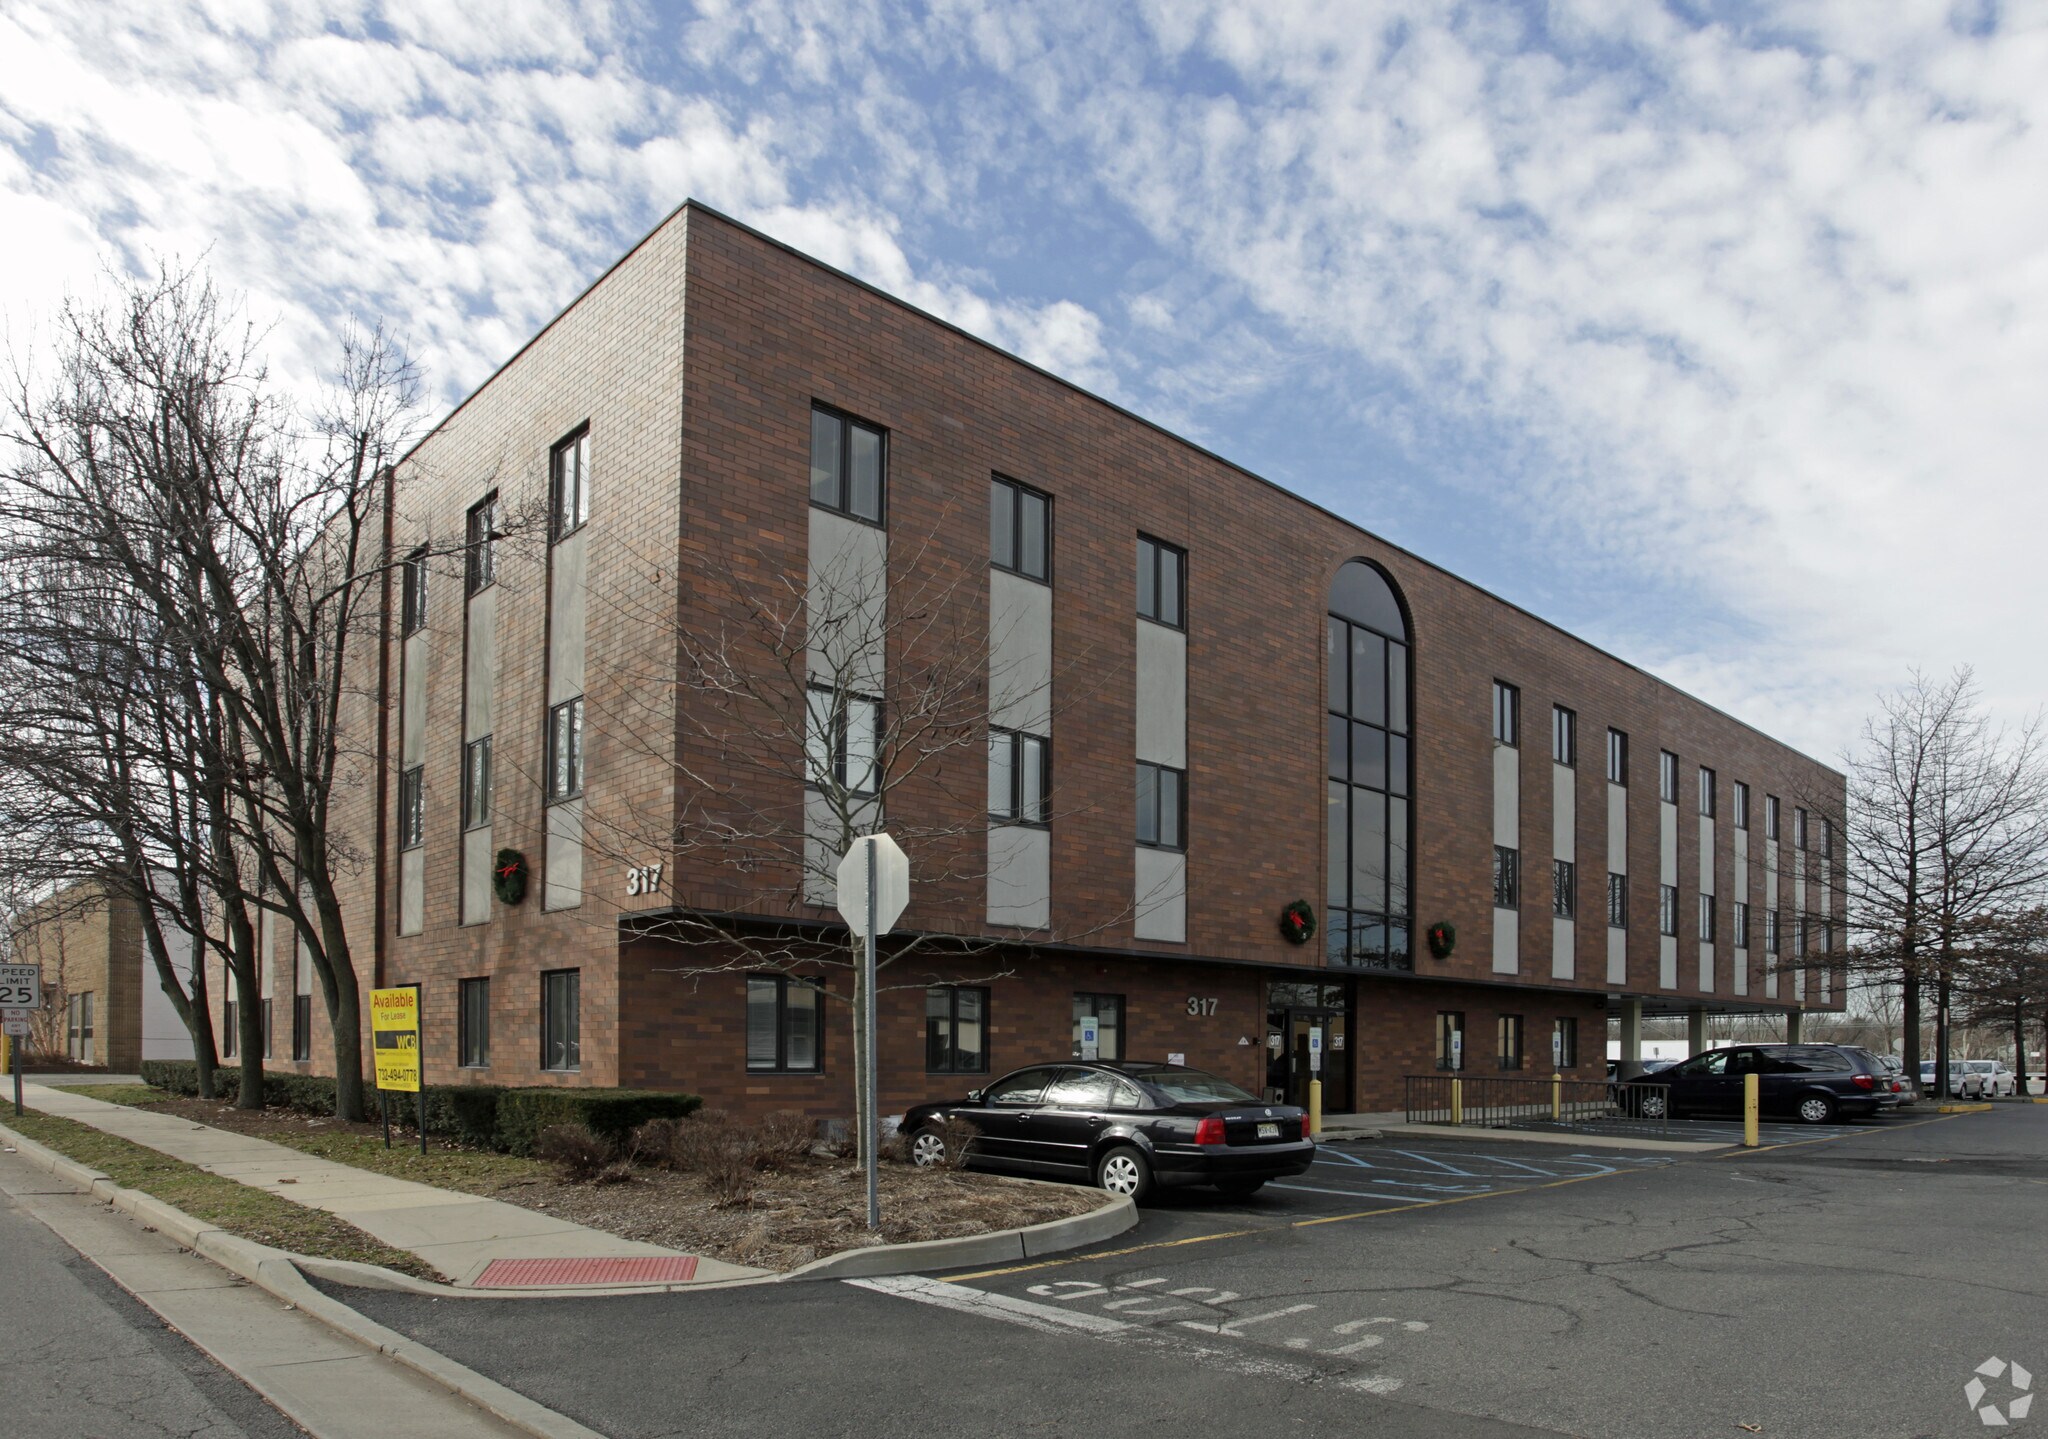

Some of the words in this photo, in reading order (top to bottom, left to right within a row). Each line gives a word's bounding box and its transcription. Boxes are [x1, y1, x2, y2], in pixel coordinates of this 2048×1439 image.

[626, 863, 663, 895] 317
[0, 987, 32, 1003] 25
[373, 993, 413, 1008] Available
[1187, 996, 1218, 1016] 317
[380, 1012, 389, 1020] For
[390, 1012, 406, 1020] Lease
[396, 1035, 416, 1049] WCB
[1270, 1035, 1280, 1045] 317
[1333, 1036, 1343, 1046] 317
[378, 1068, 417, 1082] 732-494-0778
[1027, 1278, 1430, 1356] STOP
